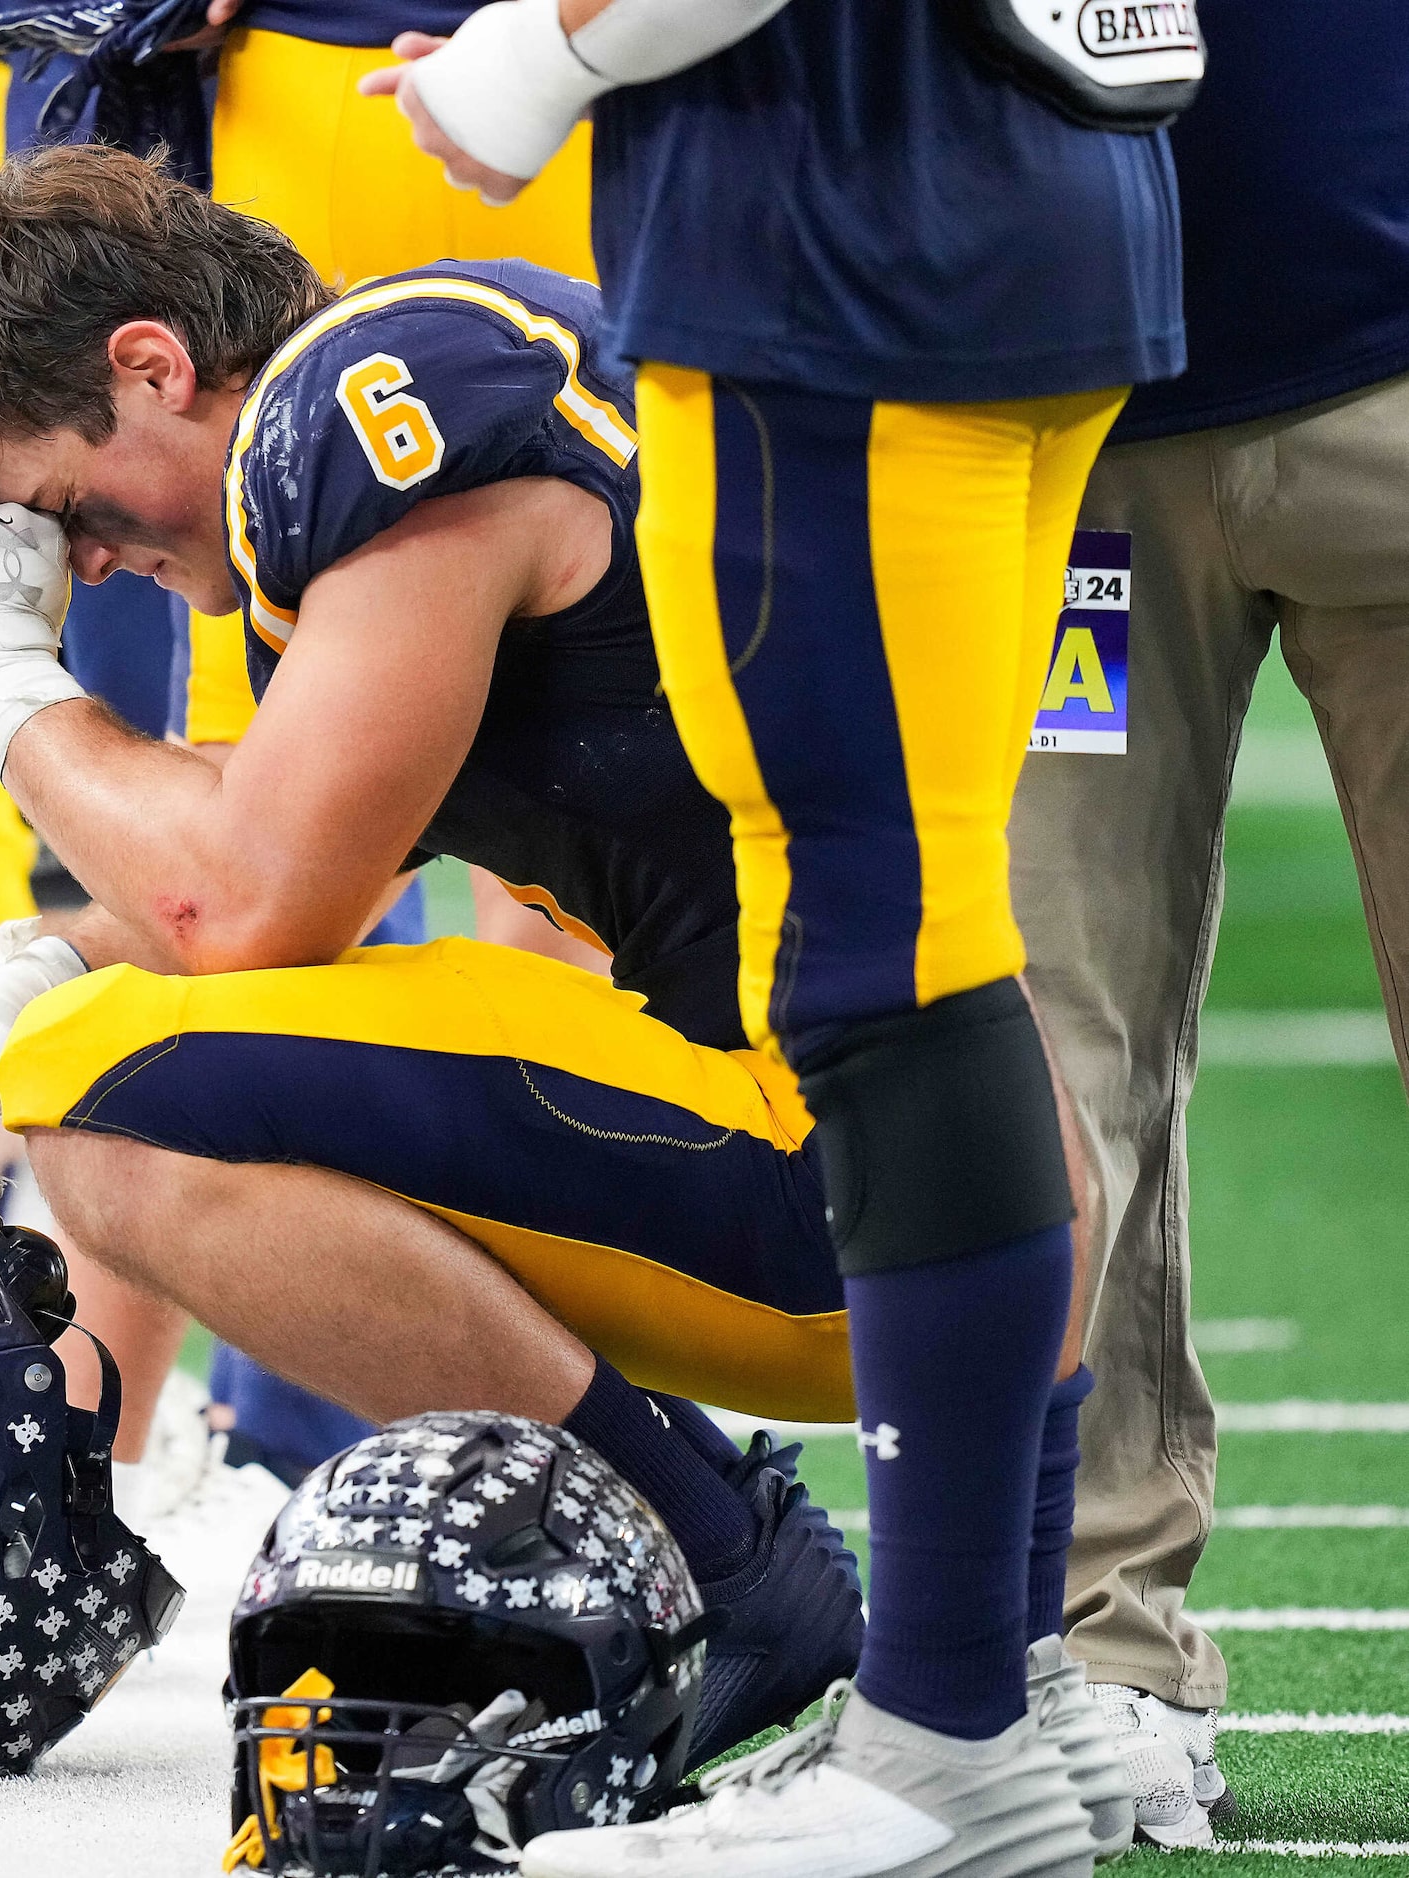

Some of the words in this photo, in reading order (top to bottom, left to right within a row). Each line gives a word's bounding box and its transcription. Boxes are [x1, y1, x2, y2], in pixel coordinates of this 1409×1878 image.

[335, 352, 446, 491] 6
[1086, 576, 1123, 601] 24
[1040, 627, 1115, 713] A
[295, 1558, 420, 1591] Riddell
